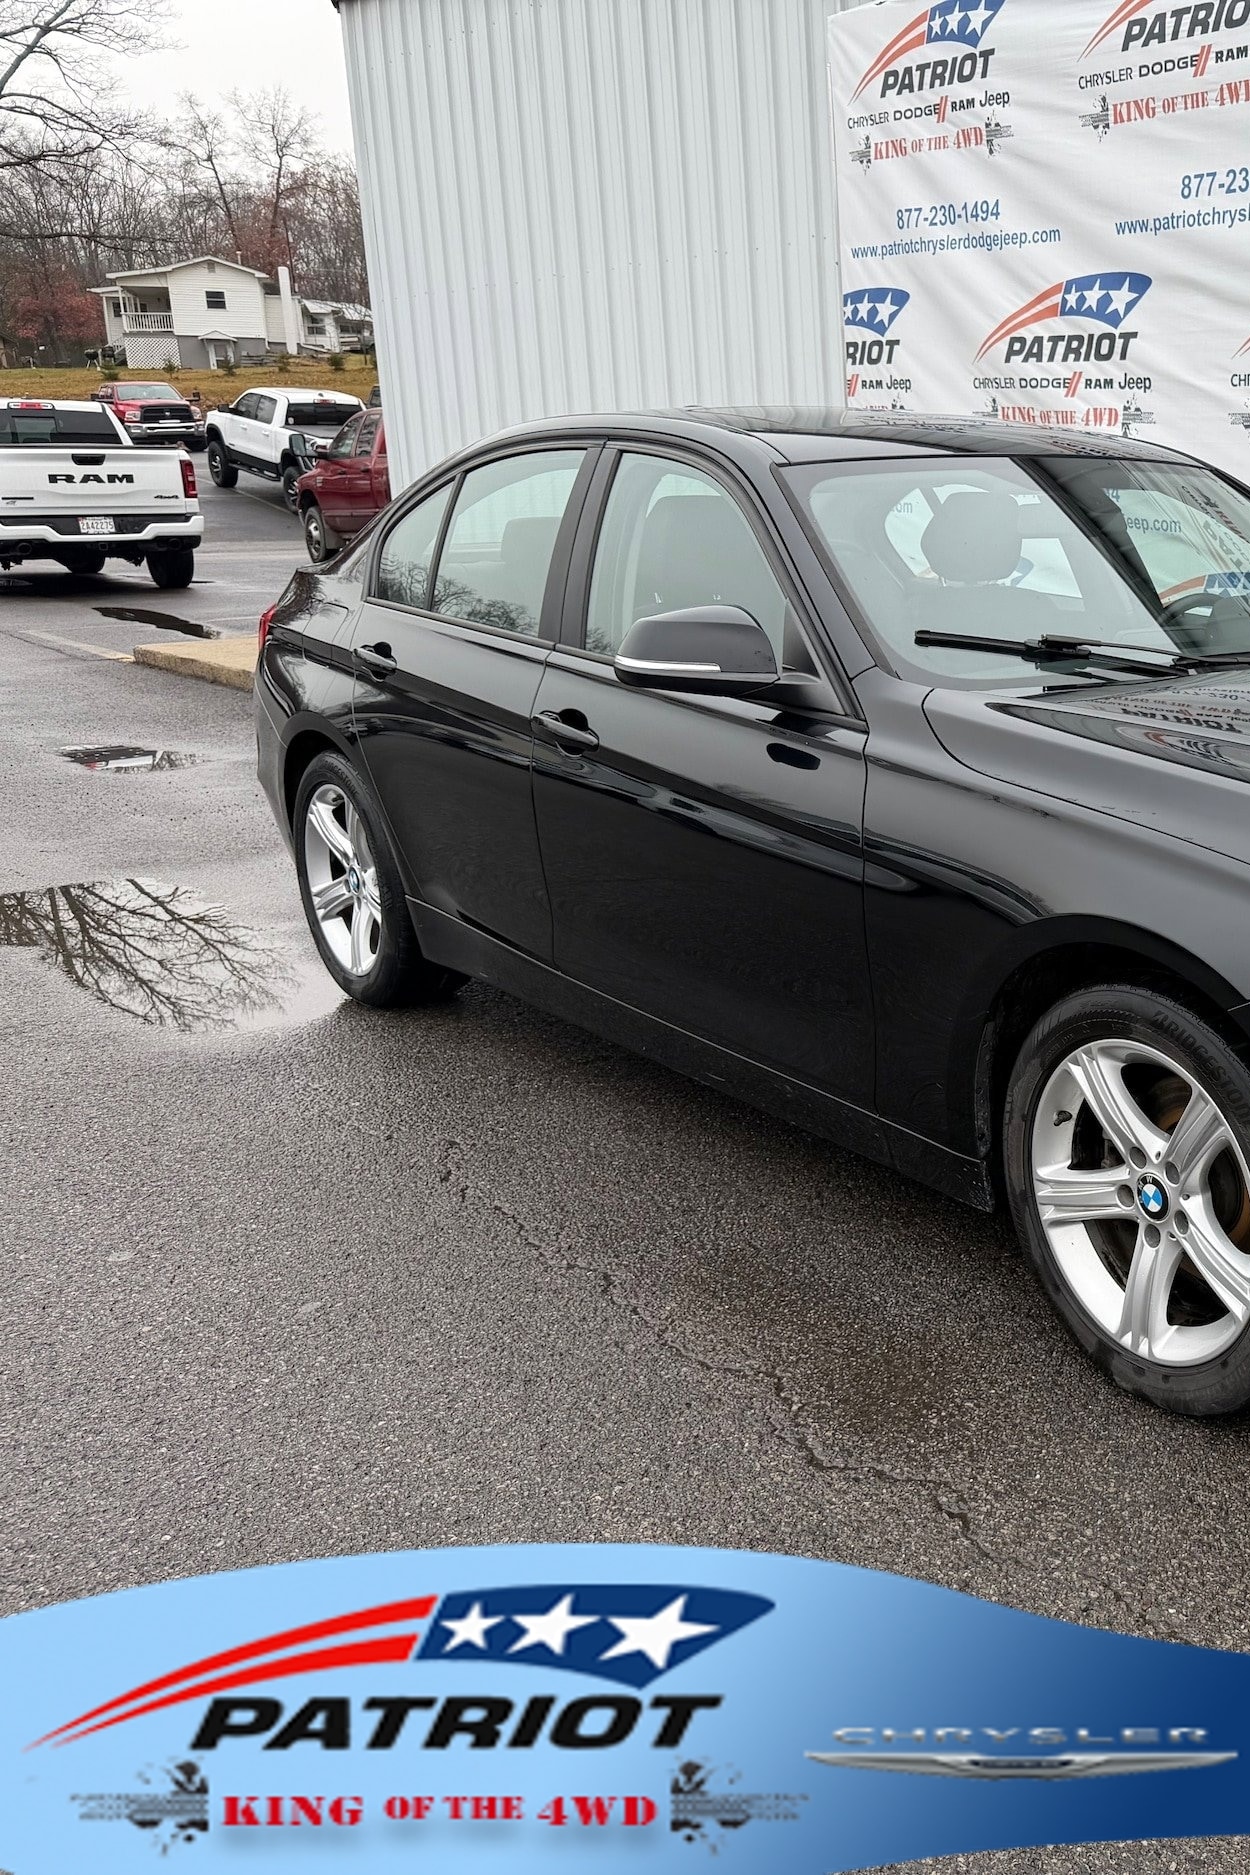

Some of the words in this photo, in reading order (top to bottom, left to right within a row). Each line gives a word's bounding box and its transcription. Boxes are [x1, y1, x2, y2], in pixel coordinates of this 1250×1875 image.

[880, 48, 995, 98] PATRIOT
[1079, 67, 1133, 89] CHRYSLER
[1139, 54, 1199, 78] DODGE
[1215, 45, 1248, 63] RAM
[848, 112, 889, 129] CHRYSLER
[893, 103, 940, 121] DODGE
[951, 98, 975, 112] RAM
[980, 90, 1009, 108] Jeep
[1113, 97, 1156, 124] KING
[1162, 97, 1178, 114] OF
[1181, 91, 1208, 110] THE
[874, 138, 907, 160] KING
[911, 139, 924, 153] OF
[927, 136, 949, 151] THE
[953, 127, 983, 149] 4WD
[897, 199, 1002, 232] 877-230-1494
[851, 229, 1060, 260] www.patriotchryslerdodgejeep.com
[1005, 332, 1138, 363] PATRIOT
[862, 380, 883, 389] RAM
[886, 375, 911, 393] Jeep
[973, 377, 1016, 389] CHRYSLER
[1019, 377, 1070, 389] DODGE
[1085, 379, 1113, 389] RAM
[1119, 373, 1151, 393] Jeep
[1001, 406, 1036, 424] KING
[1040, 411, 1051, 424] OF
[1054, 411, 1076, 424] THE
[1081, 408, 1118, 426] 4WD
[48, 474, 134, 484] RAM
